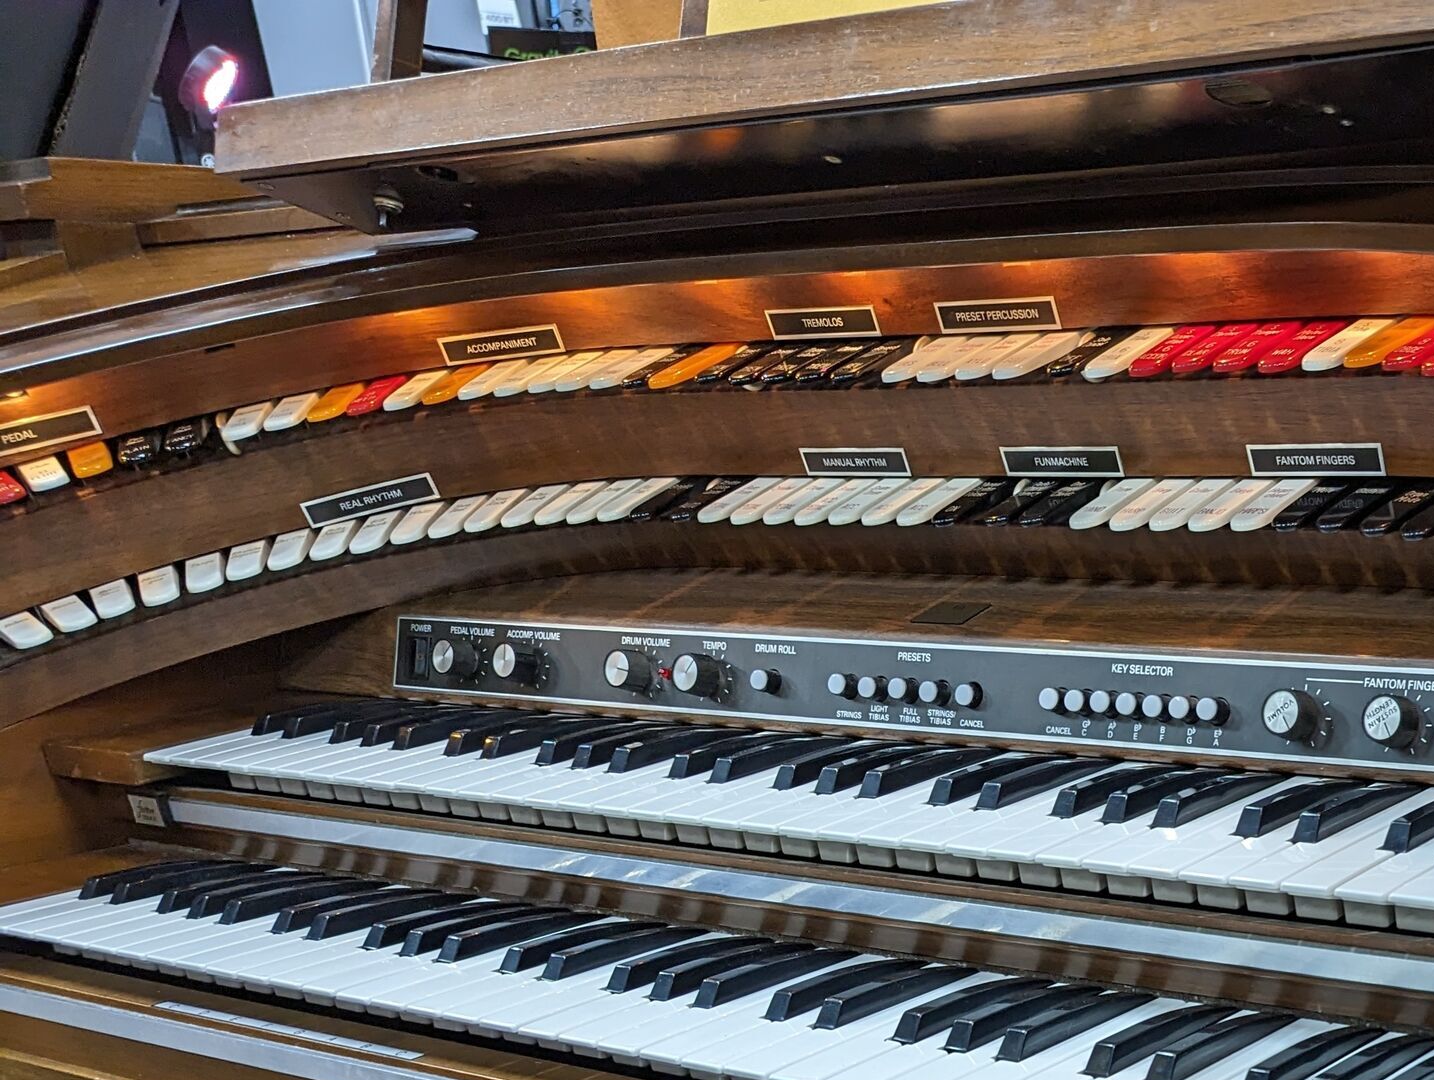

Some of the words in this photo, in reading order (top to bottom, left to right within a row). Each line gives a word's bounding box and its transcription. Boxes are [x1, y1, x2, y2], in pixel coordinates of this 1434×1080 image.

[955, 310, 987, 323] PRESET
[986, 308, 1041, 321] PERCUSSION
[801, 316, 844, 329] TREMOLOS
[466, 336, 537, 354] ACCOMPANIMENT
[1, 429, 38, 445] PEDAL
[822, 457, 855, 468] MANUAL
[855, 456, 888, 468] RHYTHM
[1033, 455, 1090, 468] FUNMACHINE
[1275, 455, 1314, 468] FANTOM
[1315, 454, 1356, 467] FINGERS
[339, 496, 364, 512] REAL
[363, 488, 403, 507] RHYTHM
[410, 623, 432, 632] POWER
[450, 626, 469, 635] PEDAL
[470, 627, 495, 637] VOLUME
[533, 632, 561, 641] VOLUME
[621, 636, 642, 645] DRUM
[642, 637, 671, 647] VOLUME
[702, 640, 727, 650] TEMPO
[755, 644, 777, 653] DRUM
[778, 645, 796, 654] ROLL
[897, 652, 932, 663] PRESETS
[1111, 664, 1129, 674] KEY
[1129, 665, 1174, 677] SELECTOR
[1363, 677, 1405, 691] FANTOM
[836, 710, 862, 719] STRINGS
[870, 705, 888, 713] LIGHT
[902, 706, 918, 715] FULL
[927, 709, 956, 719] STRINGS/
[1267, 698, 1295, 722] VOLUME
[1365, 698, 1393, 721] LENGTH
[868, 712, 889, 721] TIBIAS
[899, 715, 921, 724] TIBIAS
[930, 717, 951, 726] TIBIAS
[1368, 705, 1398, 729] SUSTAIN
[959, 719, 984, 728] CANCEL
[1045, 725, 1072, 736] CANCEL
[1160, 726, 1166, 734] B
